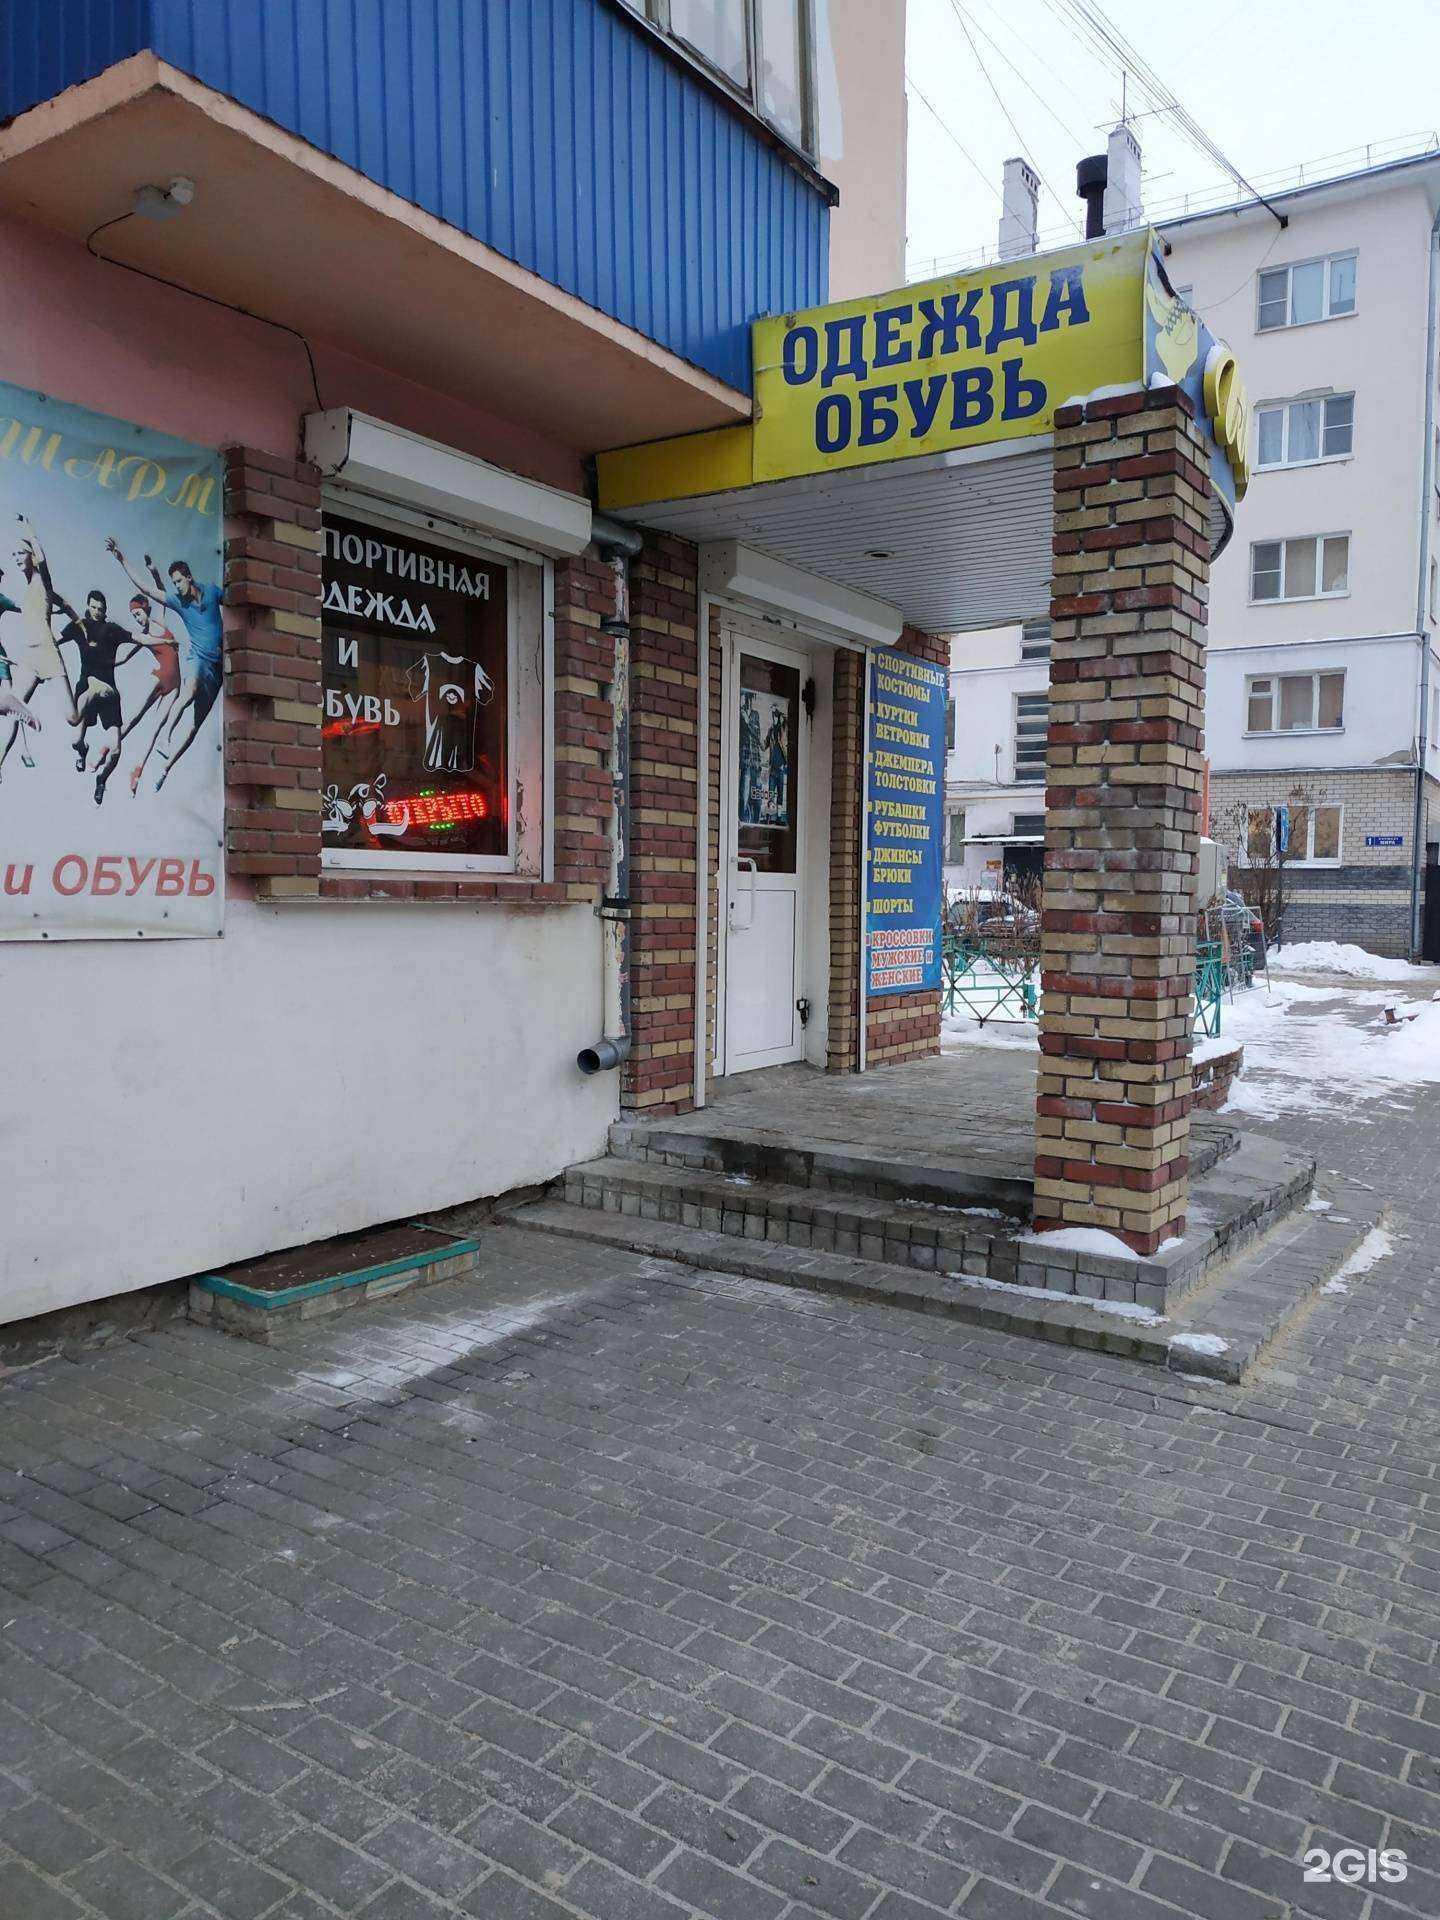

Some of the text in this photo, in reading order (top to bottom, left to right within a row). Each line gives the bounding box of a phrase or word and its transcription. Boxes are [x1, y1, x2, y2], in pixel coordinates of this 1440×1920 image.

[782, 264, 1091, 389] ОДЕЖДА
[814, 356, 1048, 454] ОБУВЬ
[321, 526, 490, 601] ПОРТИВНАЯ
[337, 637, 359, 668] И
[877, 652, 945, 688] СПОРТИВНЫЕ
[877, 672, 931, 703] КОСТЮМЫ
[321, 688, 401, 727] БУВЬ
[876, 702, 919, 727] КУРТКИ
[875, 722, 931, 749] ВЕТРОВКИ
[875, 750, 935, 776] ДЖЕМПЕРА
[874, 770, 937, 795] ТОЛСТОВКИ
[874, 799, 927, 820] РУБАШКИ
[873, 820, 931, 841] ФУТБОЛКИ
[873, 847, 923, 865] ДЖИНСЫ
[51, 853, 216, 897] ОБУВЬ
[872, 867, 912, 884] БРЮКИ
[872, 898, 914, 914] ШОРТЫ
[871, 928, 934, 949] КРОССОВКИ
[871, 947, 925, 969] МУЖСКИЕ
[870, 966, 923, 990] ЖЕНСКИЕ
